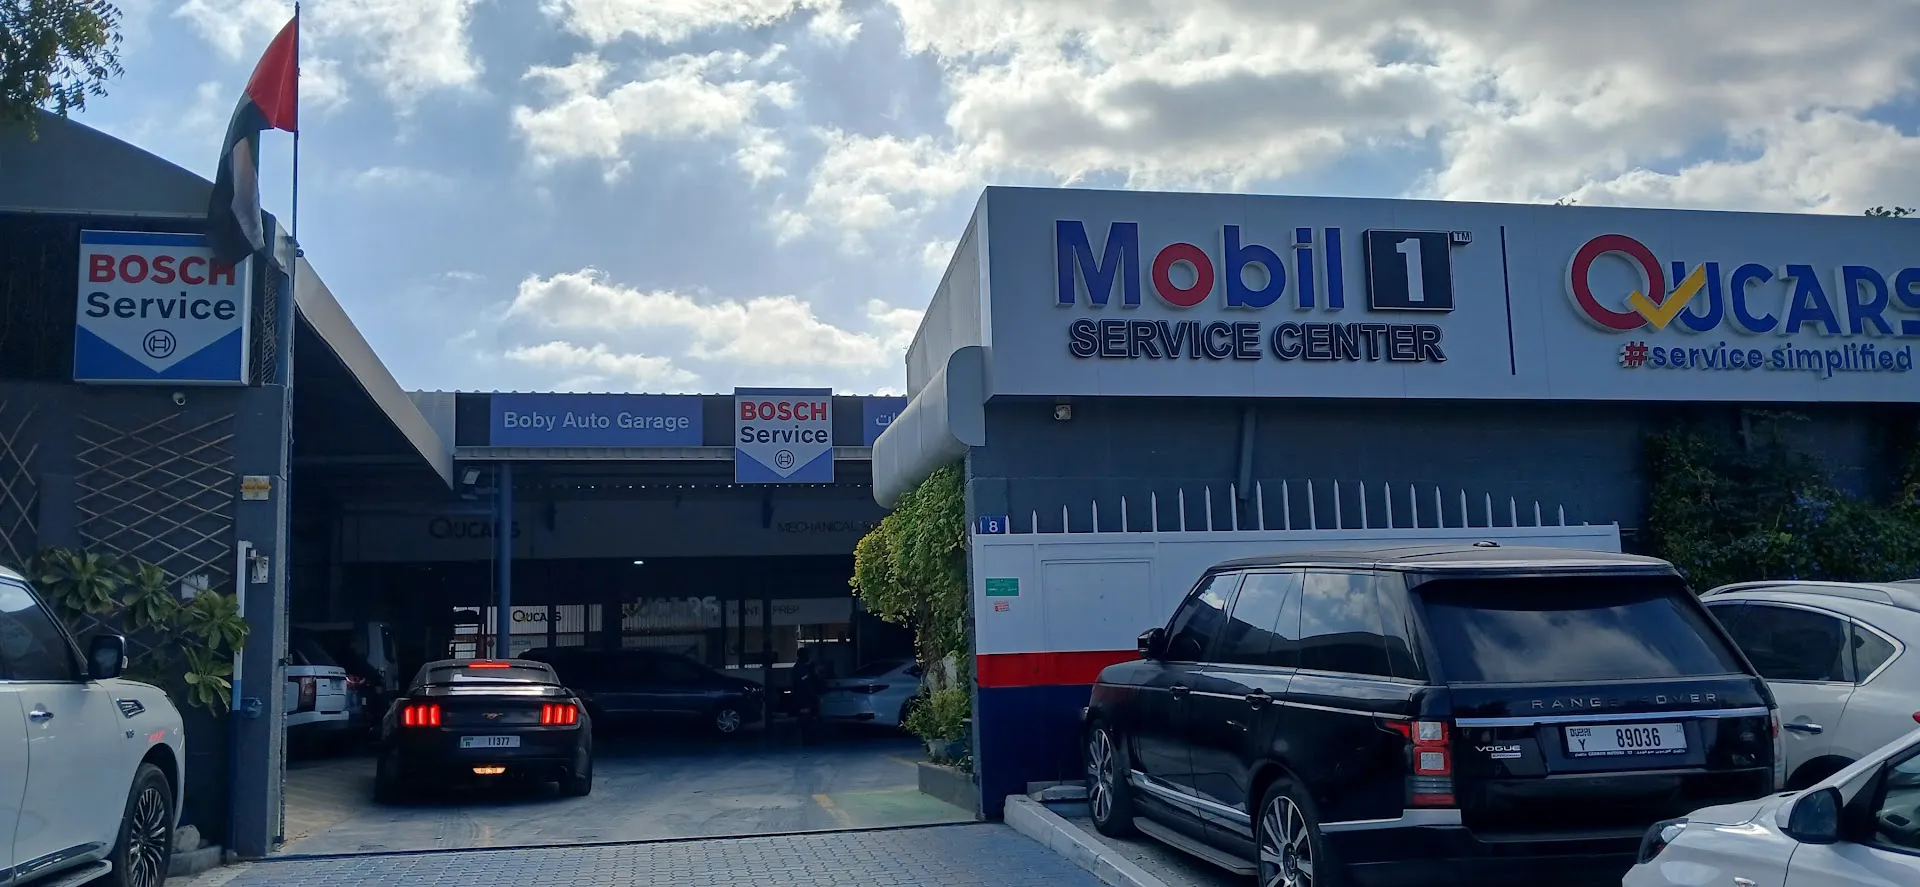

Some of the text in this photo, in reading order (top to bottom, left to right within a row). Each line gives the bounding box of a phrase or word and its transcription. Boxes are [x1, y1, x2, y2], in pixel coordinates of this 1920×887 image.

[1454, 232, 1470, 241] TM
[88, 253, 236, 286] BOSCH
[1055, 219, 1345, 310] Mobil
[85, 291, 236, 320] Service
[1069, 318, 1448, 362] SERVICE CENTER
[1621, 341, 1913, 378] #service simplified
[503, 411, 690, 433] Boby Auto Garage
[739, 401, 828, 422] BOSCH
[739, 425, 829, 444] Service
[988, 520, 999, 533] 8
[512, 610, 562, 622] QUCAS
[488, 737, 509, 746] 11377
[1578, 738, 1586, 751] Y
[1616, 727, 1661, 748] 89036
